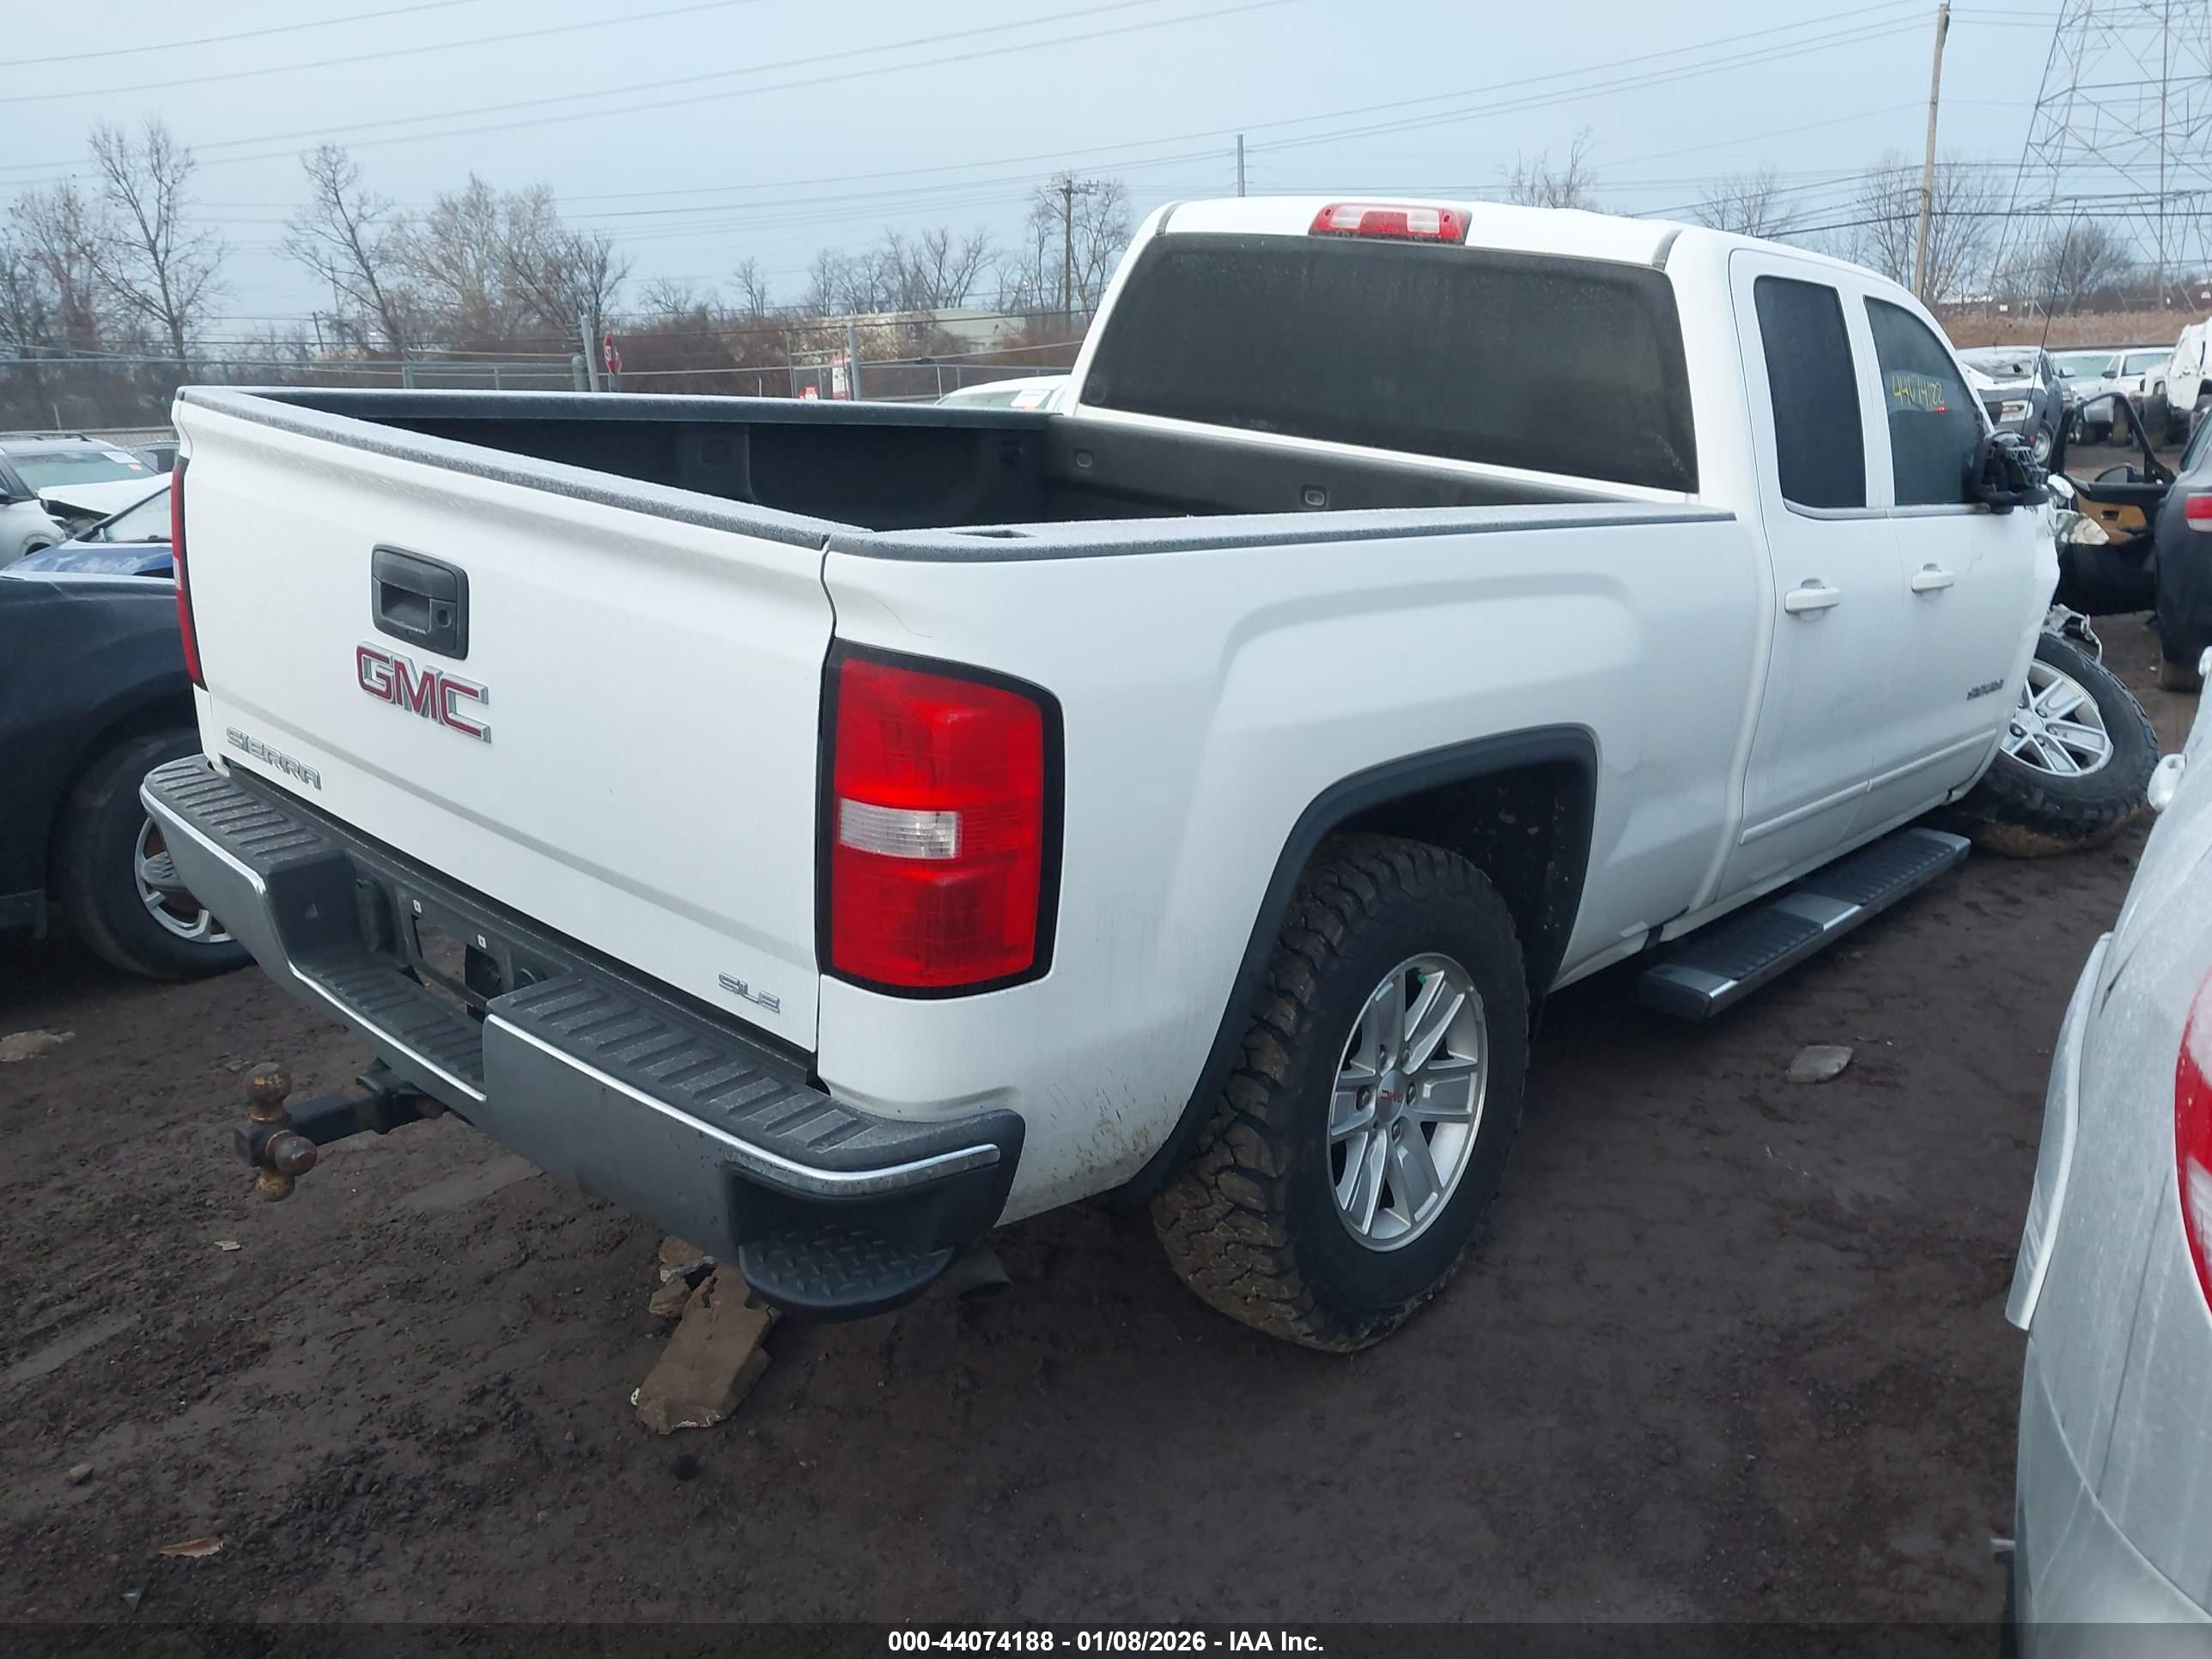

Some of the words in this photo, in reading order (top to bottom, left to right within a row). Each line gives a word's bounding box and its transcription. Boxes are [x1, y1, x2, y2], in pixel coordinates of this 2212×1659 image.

[356, 641, 492, 744] GMC
[226, 726, 322, 791] SIERRA
[718, 971, 781, 1014] SLE
